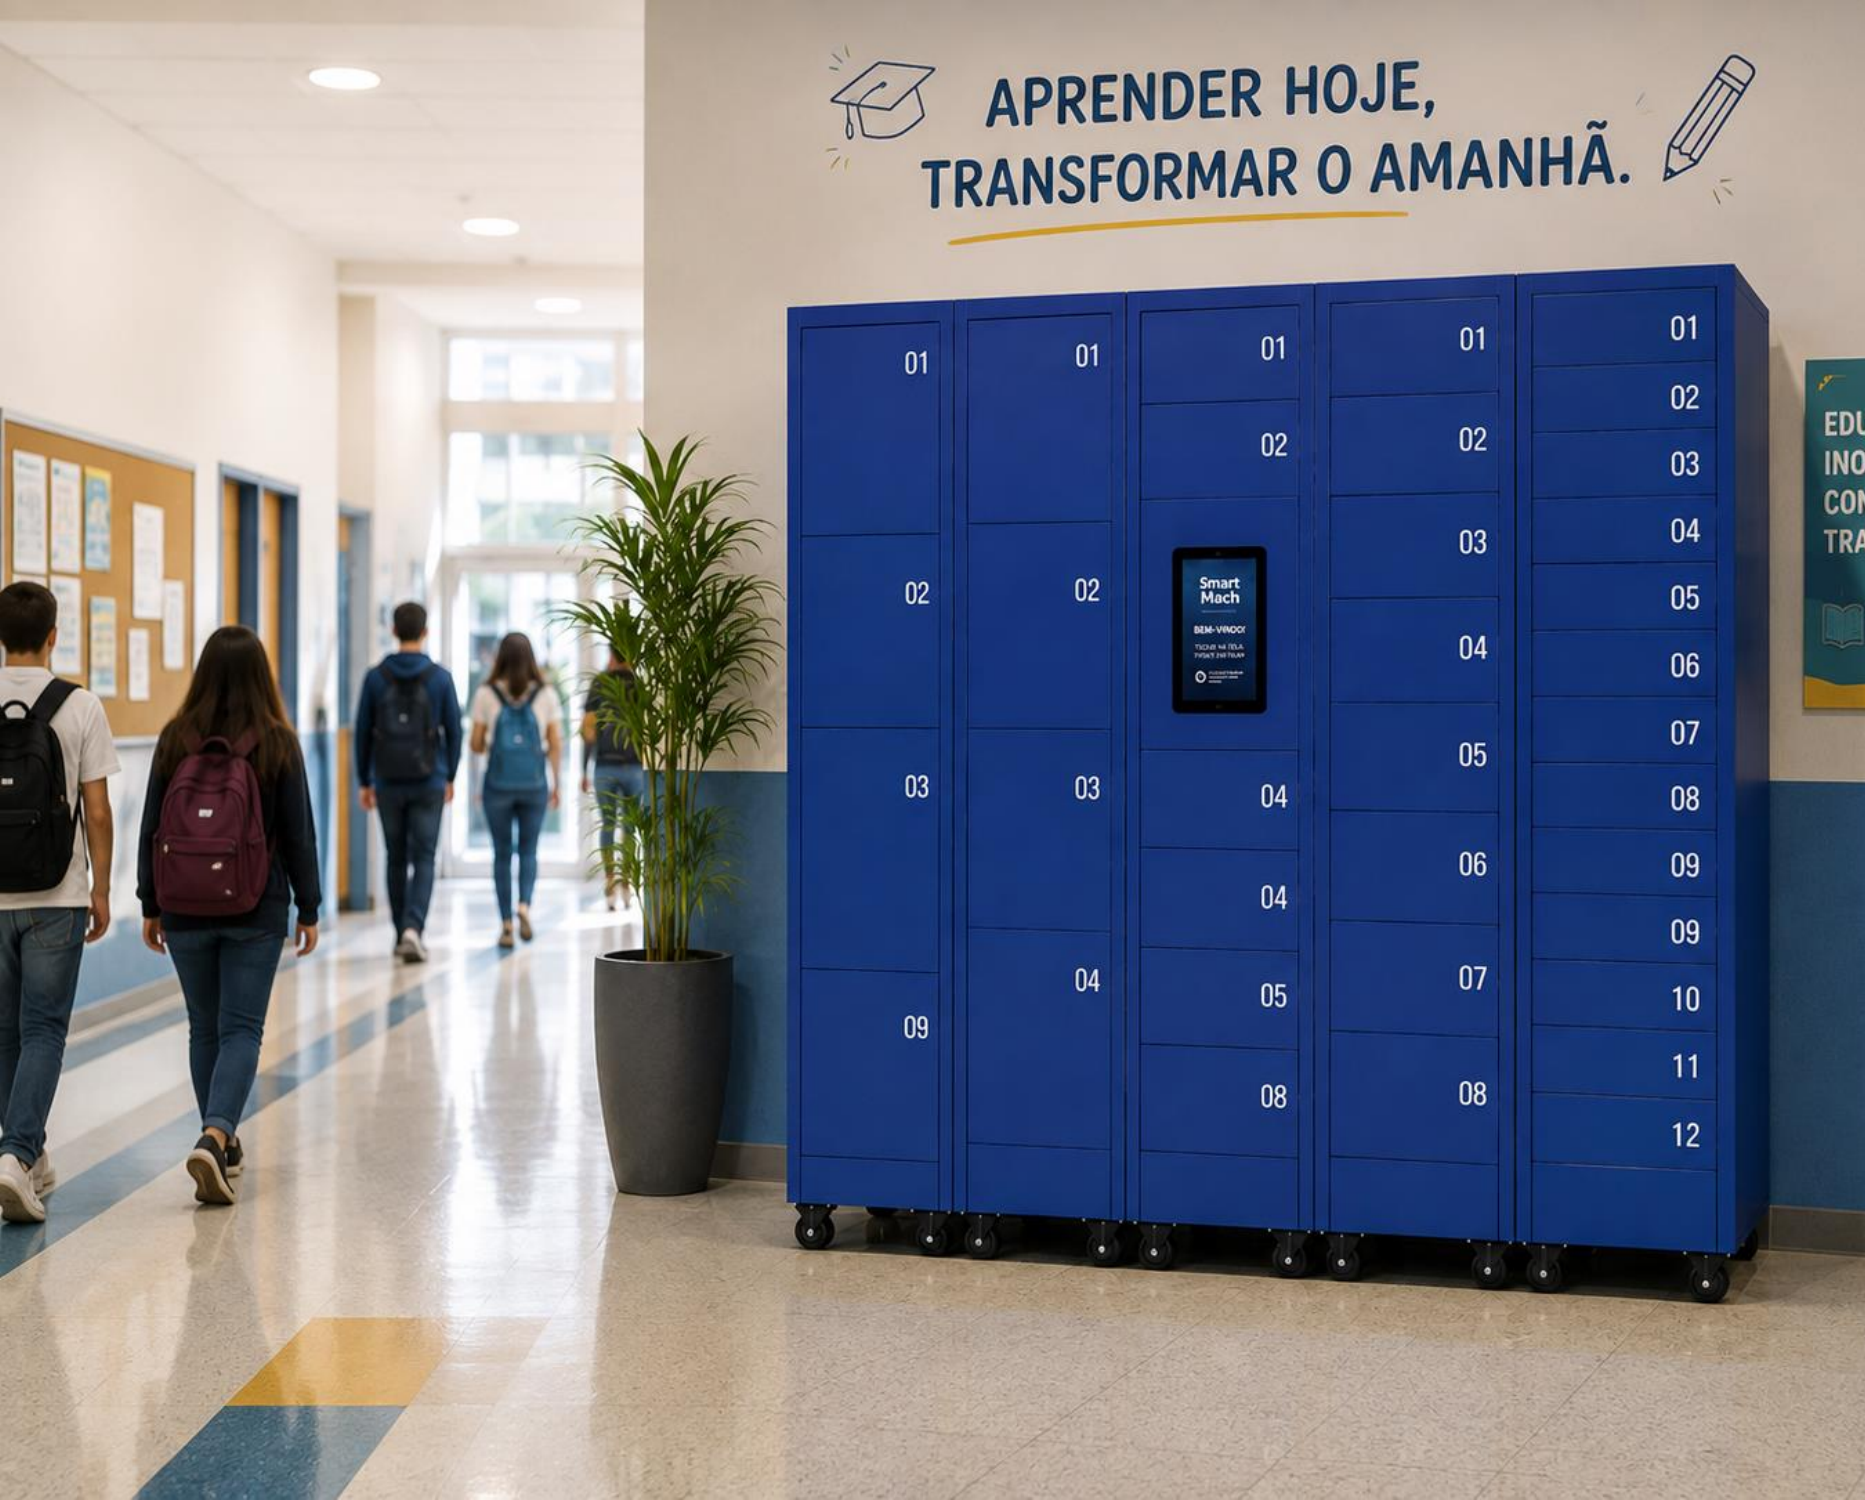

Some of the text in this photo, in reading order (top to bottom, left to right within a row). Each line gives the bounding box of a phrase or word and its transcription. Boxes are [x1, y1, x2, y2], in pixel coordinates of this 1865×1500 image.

[985, 60, 1435, 128] APRENDER HOJE,
[921, 120, 1630, 209] TRANSFORMAR O AMANHÃ.
[1459, 326, 1487, 352] 01
[1669, 314, 1698, 341] 01
[1074, 343, 1099, 368] 01
[1260, 335, 1287, 361] 01
[904, 350, 928, 375] 01
[1671, 384, 1700, 410] 02
[1824, 410, 1865, 437] EDU
[1261, 432, 1288, 457] 02
[1459, 426, 1487, 452] 02
[1671, 450, 1700, 477] 03
[1824, 449, 1865, 476] INO
[1459, 529, 1487, 555] 03
[1671, 517, 1701, 543] 04
[1823, 529, 1865, 554] TRA
[904, 580, 930, 605] 02
[1074, 577, 1100, 602] 02
[1199, 576, 1240, 589] Smart
[1200, 591, 1240, 605] Mach
[1671, 584, 1700, 611] 05
[1459, 635, 1488, 660] 04
[1671, 652, 1700, 678] 06
[1671, 720, 1700, 746] 07
[1459, 741, 1487, 767] 05
[905, 774, 929, 799] 03
[1075, 775, 1100, 800] 03
[1261, 783, 1288, 808] 04
[1671, 785, 1700, 811] 08
[1459, 851, 1487, 877] 06
[1671, 852, 1700, 878] 09
[1260, 884, 1288, 910] 04
[1671, 918, 1700, 945] 09
[1075, 967, 1101, 992] 04
[1459, 964, 1488, 991] 07
[1260, 982, 1287, 1008] 05
[1672, 985, 1700, 1012] 10
[904, 1015, 929, 1039] 09
[1673, 1053, 1700, 1079] 11
[1260, 1083, 1287, 1109] 08
[1459, 1080, 1487, 1106] 08
[1672, 1122, 1700, 1148] 12
